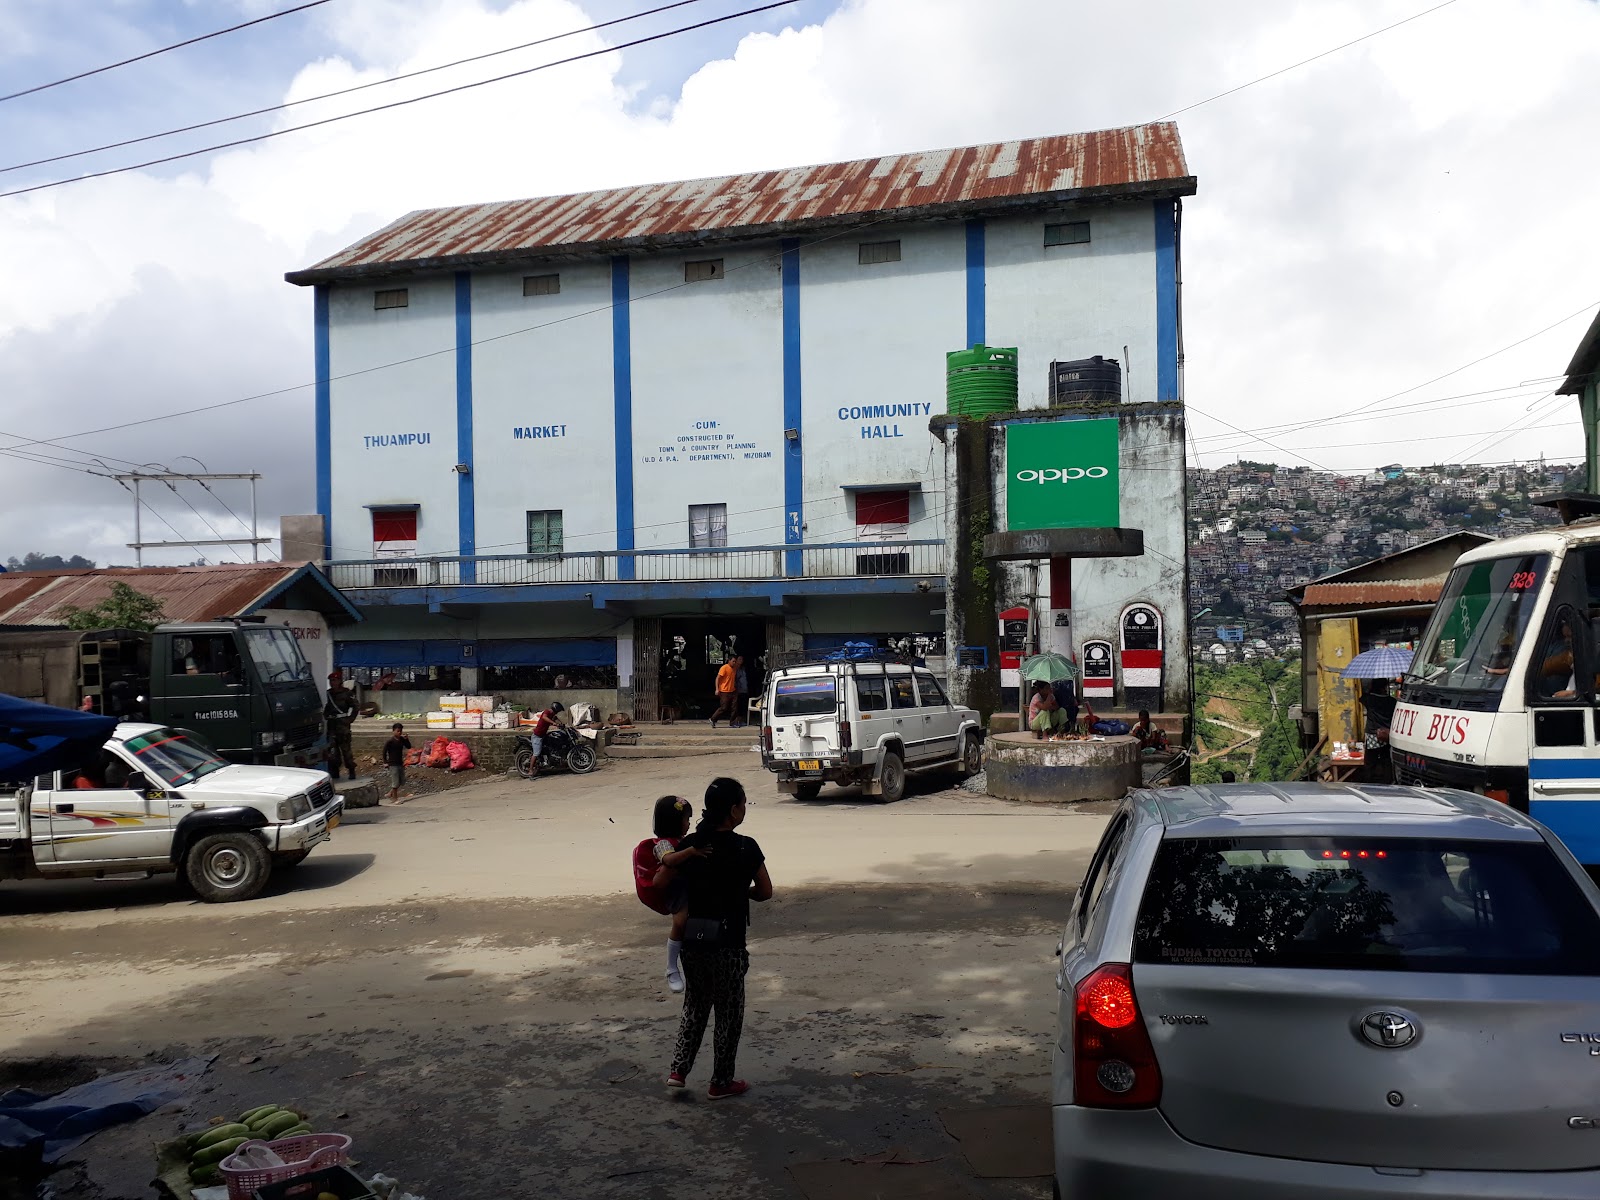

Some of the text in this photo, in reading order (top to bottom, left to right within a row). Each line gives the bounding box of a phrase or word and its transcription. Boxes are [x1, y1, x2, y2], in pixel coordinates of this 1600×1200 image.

[838, 402, 931, 420] COMMUNITY
[513, 425, 567, 440] MARKET
[677, 434, 723, 442] CONSTRUCTED
[861, 425, 904, 439] HALL
[364, 432, 431, 448] THUAMPUI
[727, 442, 756, 450] PLANNING
[743, 451, 772, 459] MIZORAM
[1509, 571, 1536, 589] 328
[306, 628, 320, 640] POST
[1391, 708, 1470, 745] CITY BUS
[1466, 754, 1476, 763] EX
[1161, 948, 1253, 957] BUDHA TOYOTA
[1159, 1014, 1208, 1025] TOYOTA
